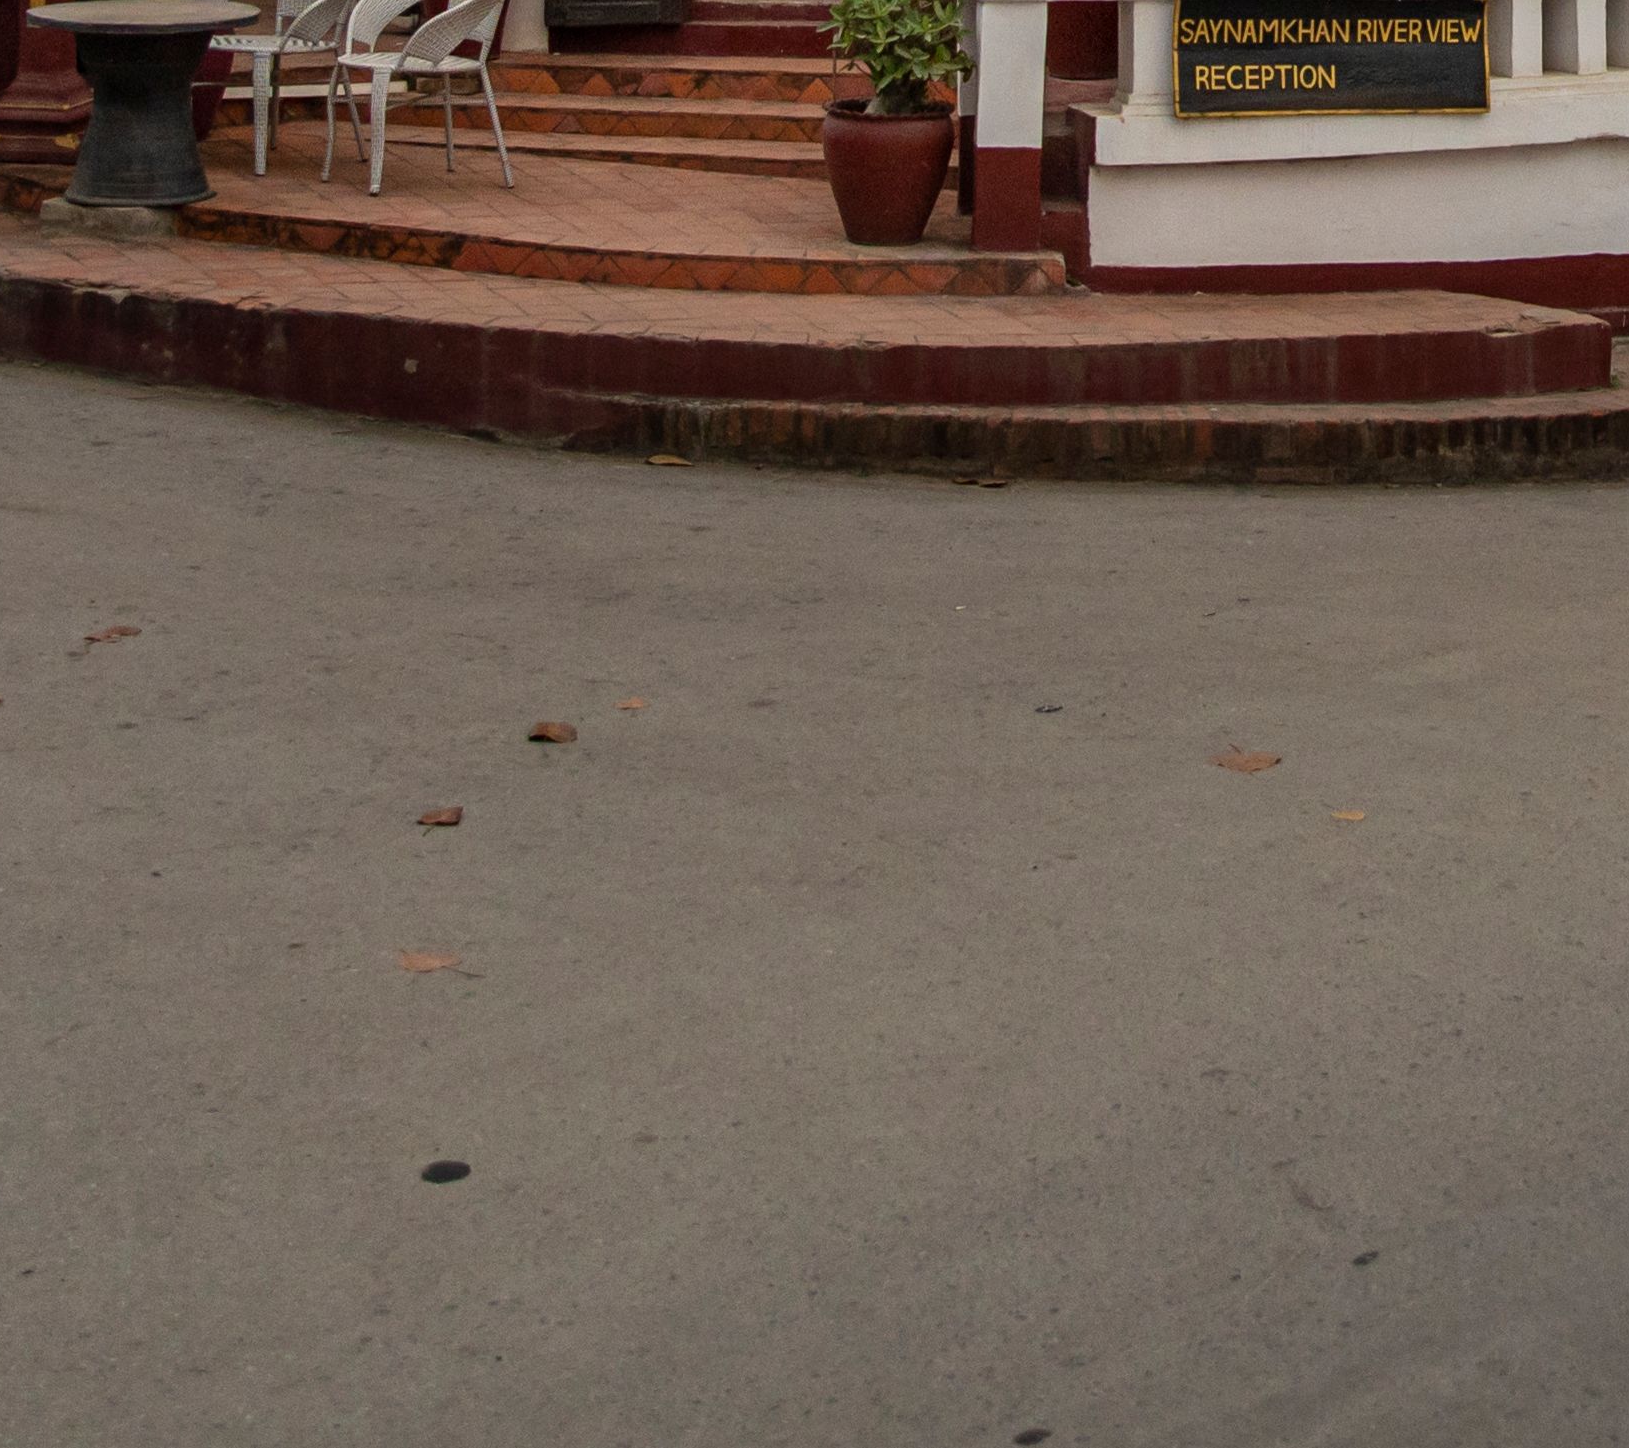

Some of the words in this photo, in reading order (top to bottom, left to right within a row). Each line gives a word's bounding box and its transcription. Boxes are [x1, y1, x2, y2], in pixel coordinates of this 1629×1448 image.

[1180, 18, 1350, 44] SAYNAMKHAN
[1357, 18, 1422, 44] RIVER
[1426, 18, 1481, 44] VIEW
[1195, 63, 1337, 91] RECEPTION
